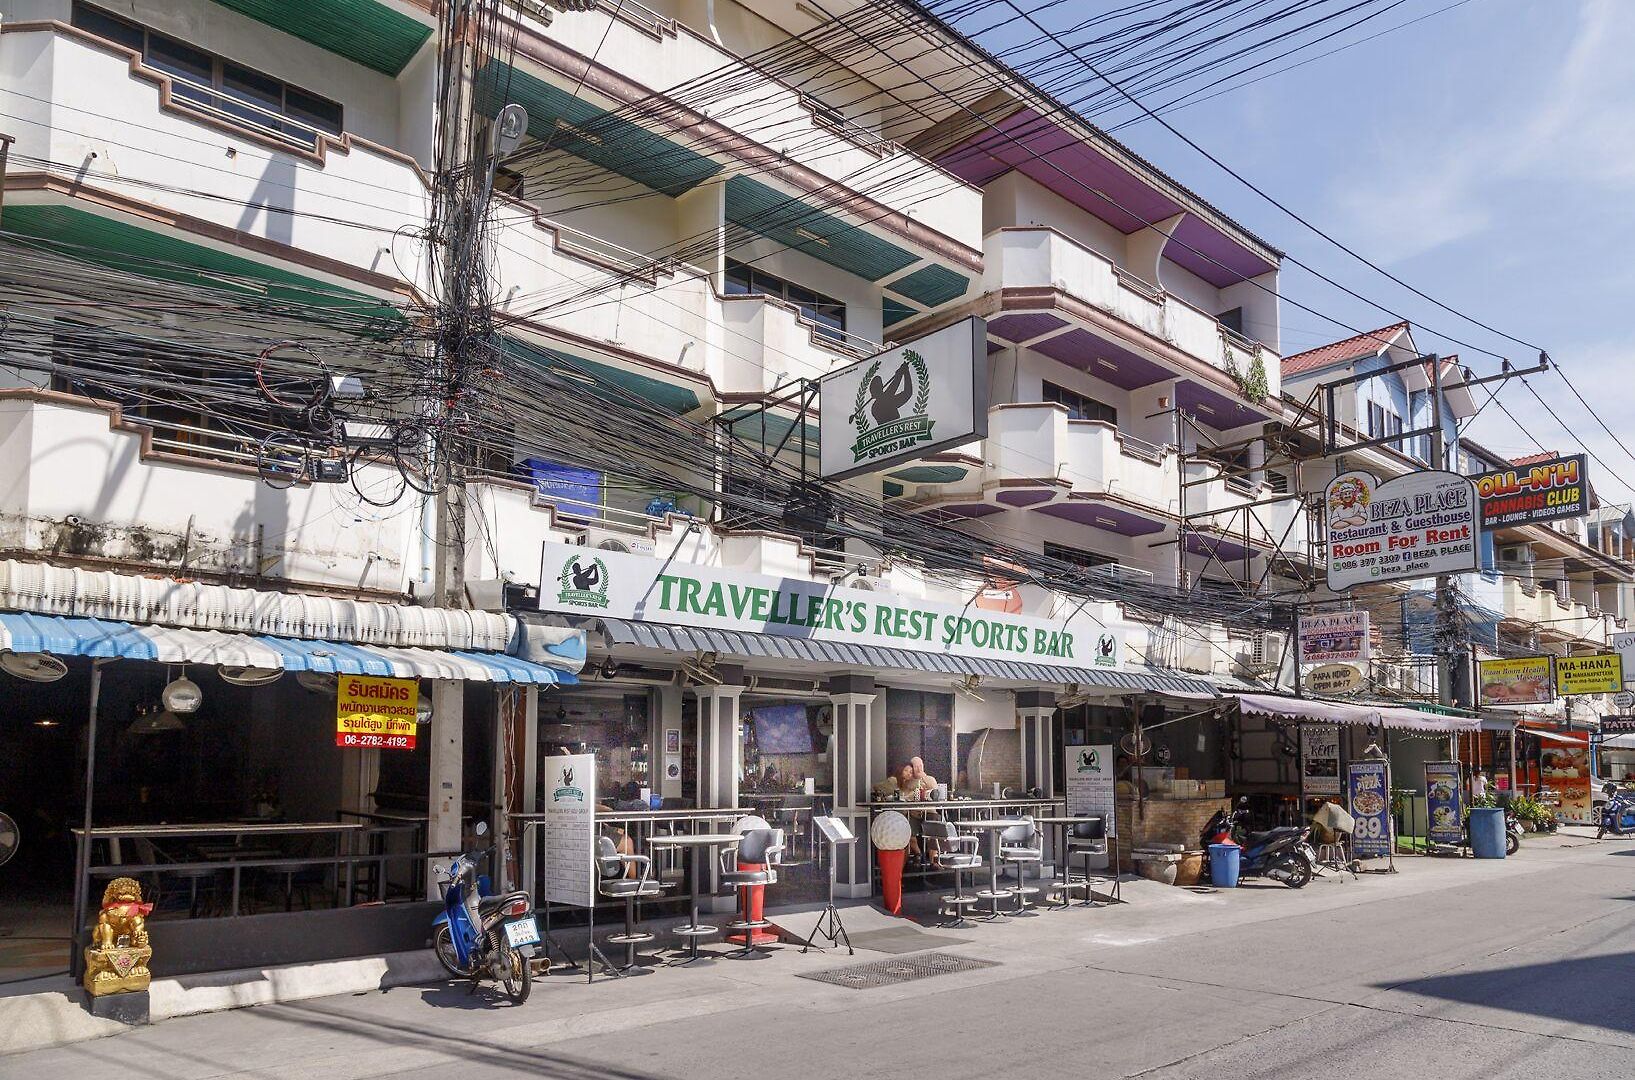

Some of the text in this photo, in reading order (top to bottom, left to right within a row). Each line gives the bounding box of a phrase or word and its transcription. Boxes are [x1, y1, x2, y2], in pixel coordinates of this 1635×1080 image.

[861, 421, 922, 447] TRAVELLER'S REST
[867, 437, 917, 459] SPORTS BAR
[1474, 460, 1579, 498] OLL-N'H
[1370, 487, 1468, 522] BEZA PLACE
[1484, 487, 1581, 516] CANNABIS CLUB
[1485, 516, 1498, 525] BAR
[1502, 511, 1528, 522] LOUNGE
[1556, 503, 1580, 514] GAMES
[1330, 510, 1472, 543] Restaurant & Guesthouse
[1332, 524, 1471, 559] Room For Rent
[1341, 543, 1472, 570] 086 377 3307 BEZA PLACE
[658, 574, 1075, 659] TRAVELLER'S REST SPORTS BAR
[1522, 665, 1546, 673] Health
[1559, 659, 1612, 671] MA-HANA
[347, 679, 410, 700] รับสมัคร
[1313, 681, 1332, 690] OPEN
[340, 700, 416, 716] พนักงานสาวสวย
[343, 716, 382, 732] รายได้สูง
[344, 735, 407, 747] 06-2782-4192
[1356, 778, 1382, 791] PIZZA
[1354, 816, 1382, 839] 89
